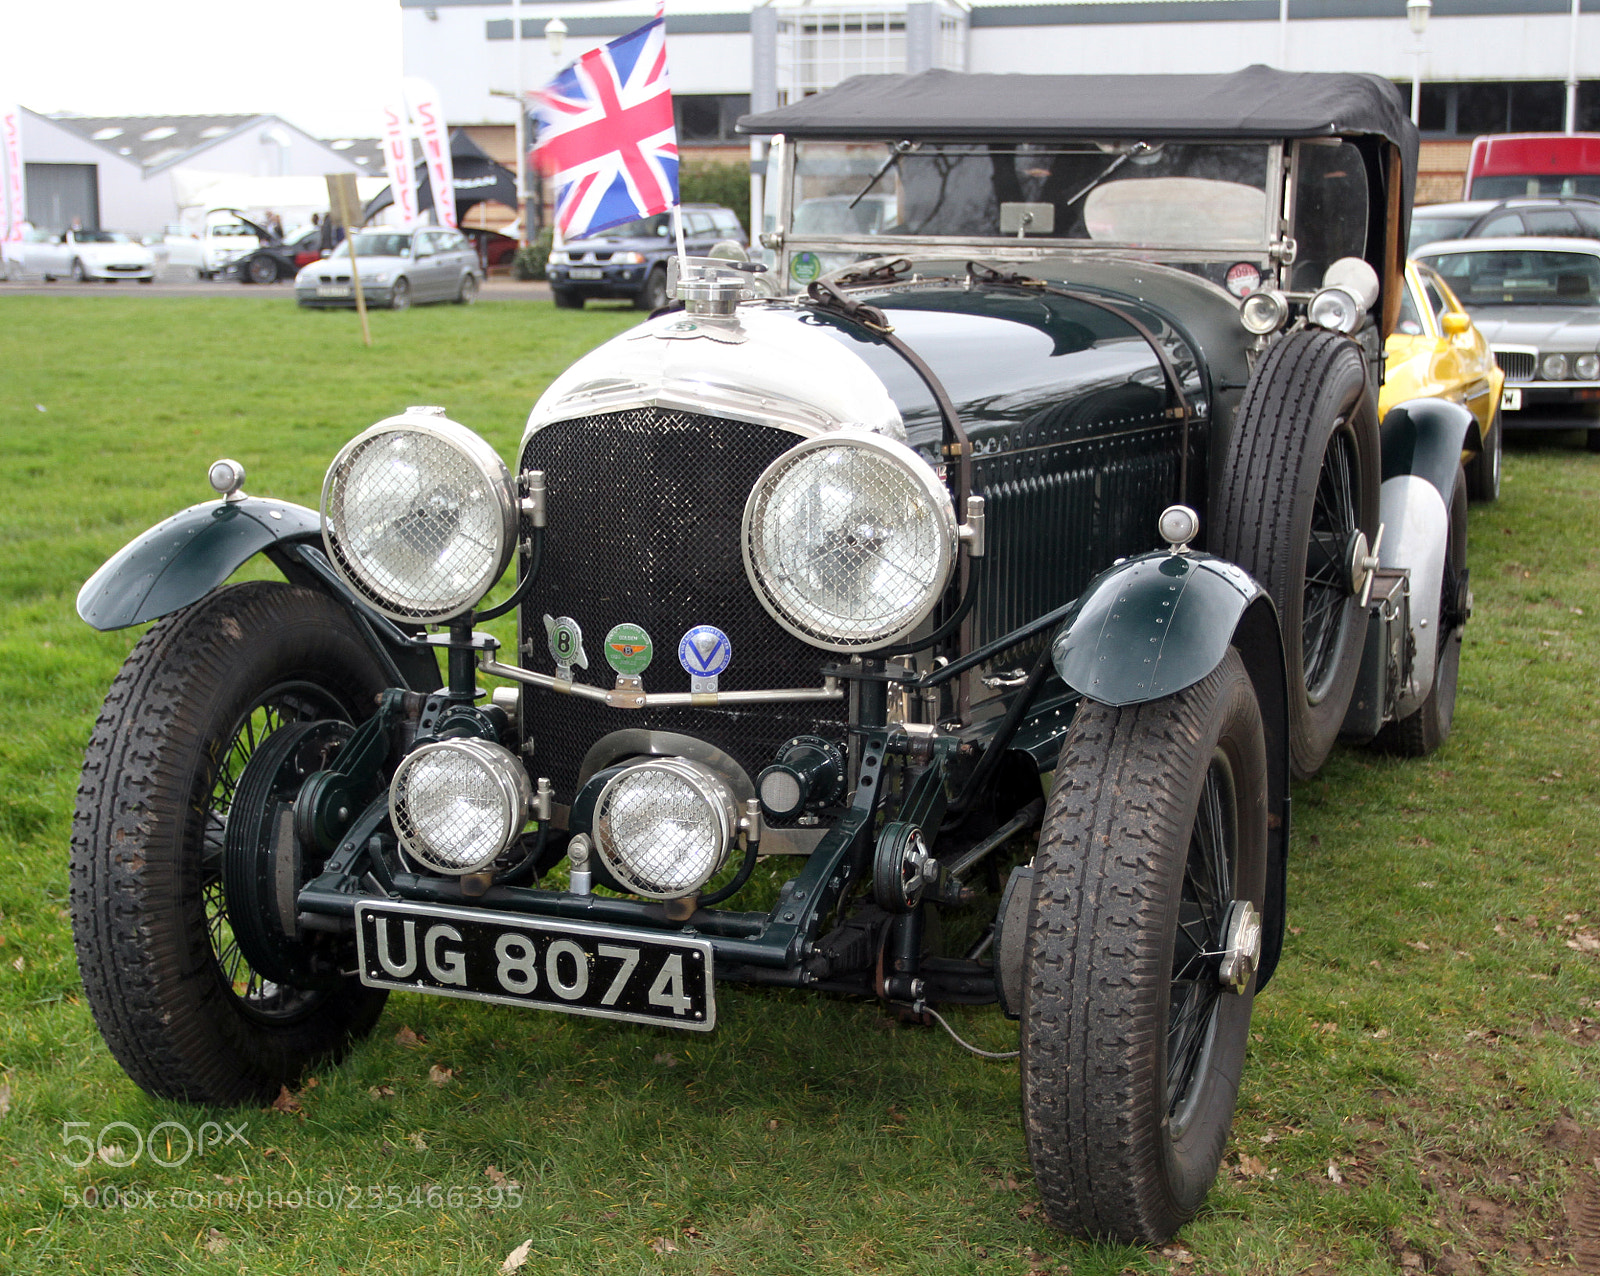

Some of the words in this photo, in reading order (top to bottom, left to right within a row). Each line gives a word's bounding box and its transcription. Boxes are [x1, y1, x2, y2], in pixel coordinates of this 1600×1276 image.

[681, 658, 690, 671] THE
[719, 654, 730, 670] CLUB
[374, 916, 468, 987] UG
[494, 932, 692, 1015] 8074
